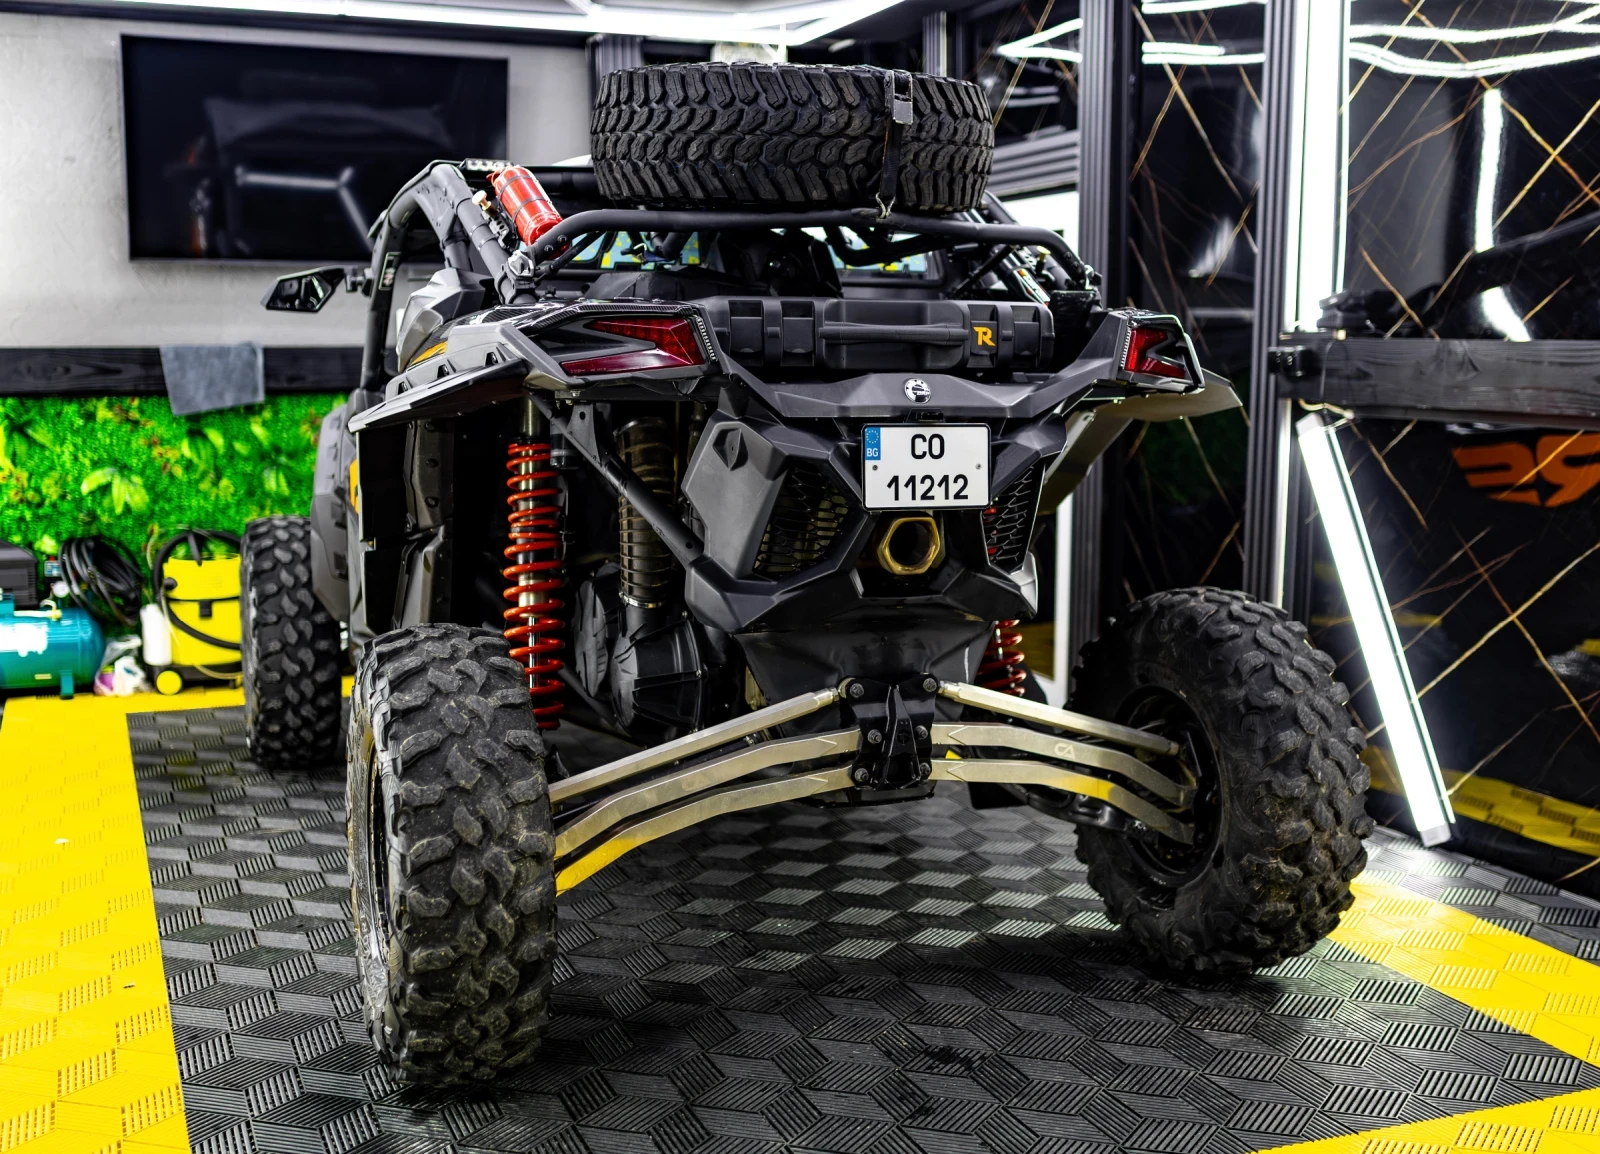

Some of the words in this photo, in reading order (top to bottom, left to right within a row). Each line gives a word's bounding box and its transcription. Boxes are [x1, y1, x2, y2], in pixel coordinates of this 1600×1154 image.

[866, 448, 879, 457] BG
[911, 433, 945, 460] CO
[887, 473, 969, 501] 11212
